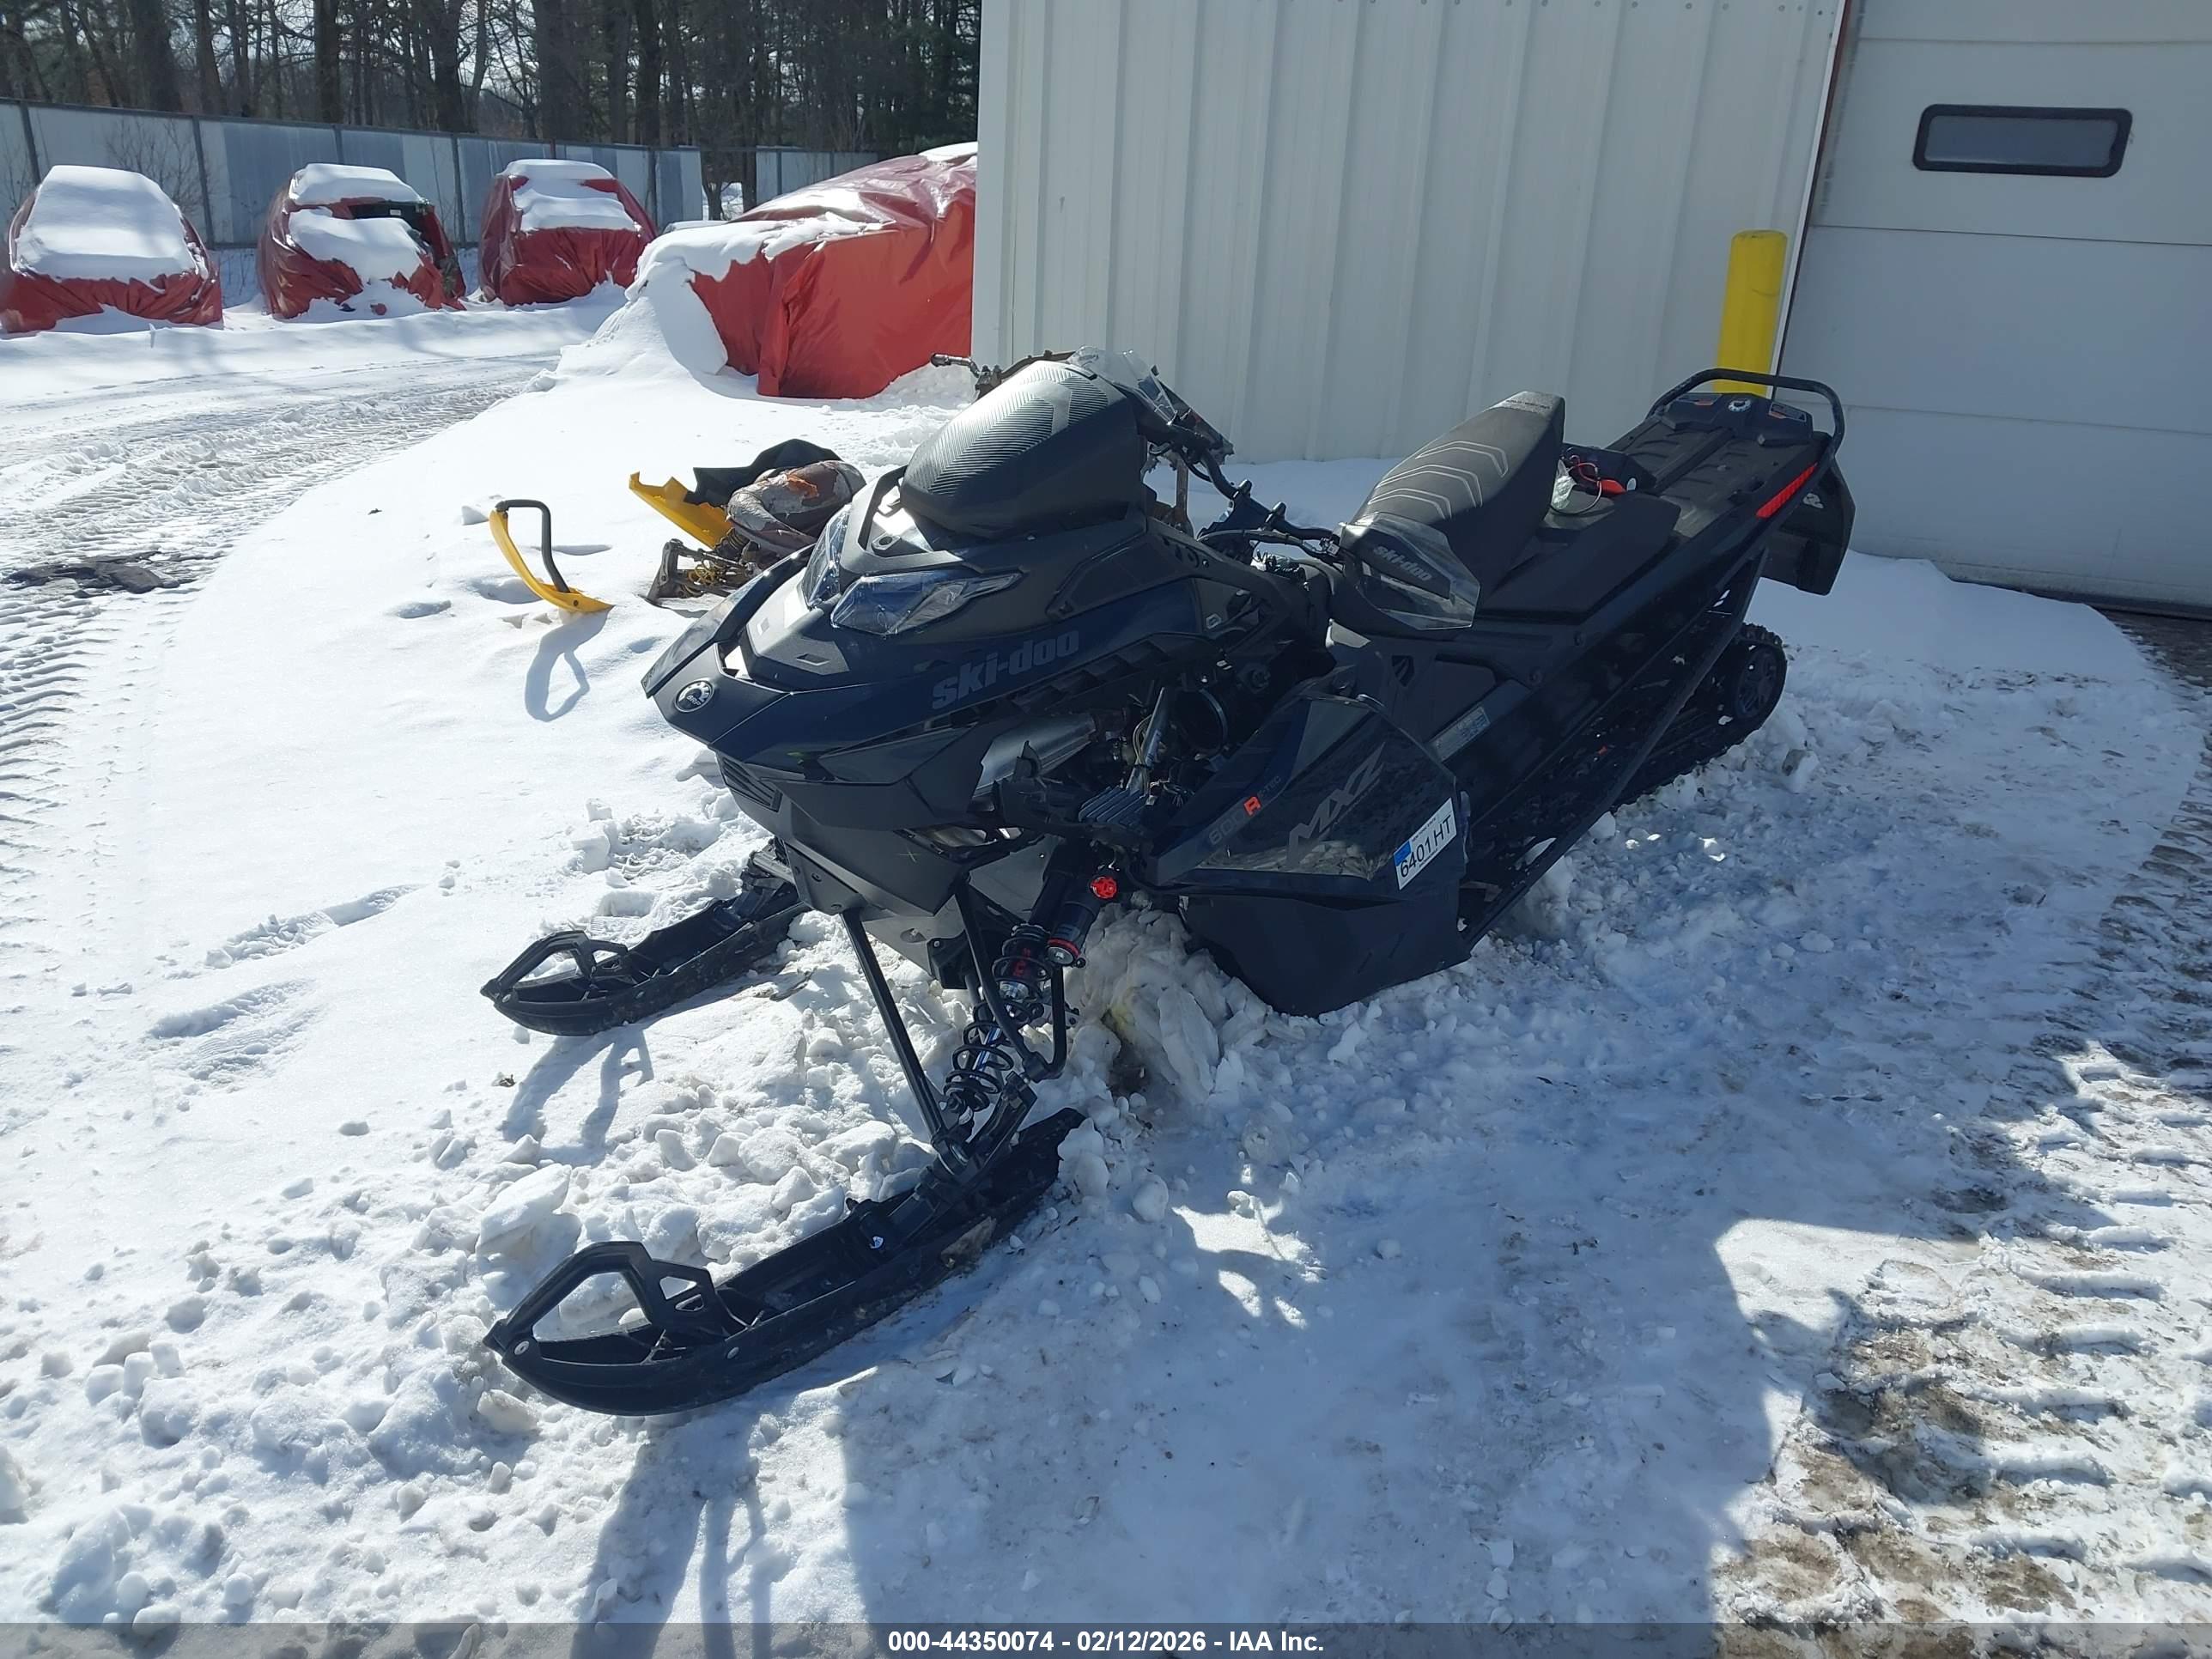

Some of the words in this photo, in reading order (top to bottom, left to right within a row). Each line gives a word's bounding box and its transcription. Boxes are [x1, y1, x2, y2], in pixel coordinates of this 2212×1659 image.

[1373, 545, 1432, 581] ski-doo
[932, 630, 1079, 709] ski-doo
[686, 695, 702, 706] BRP
[1400, 836, 1431, 878] 6401
[1433, 814, 1451, 847] HT
